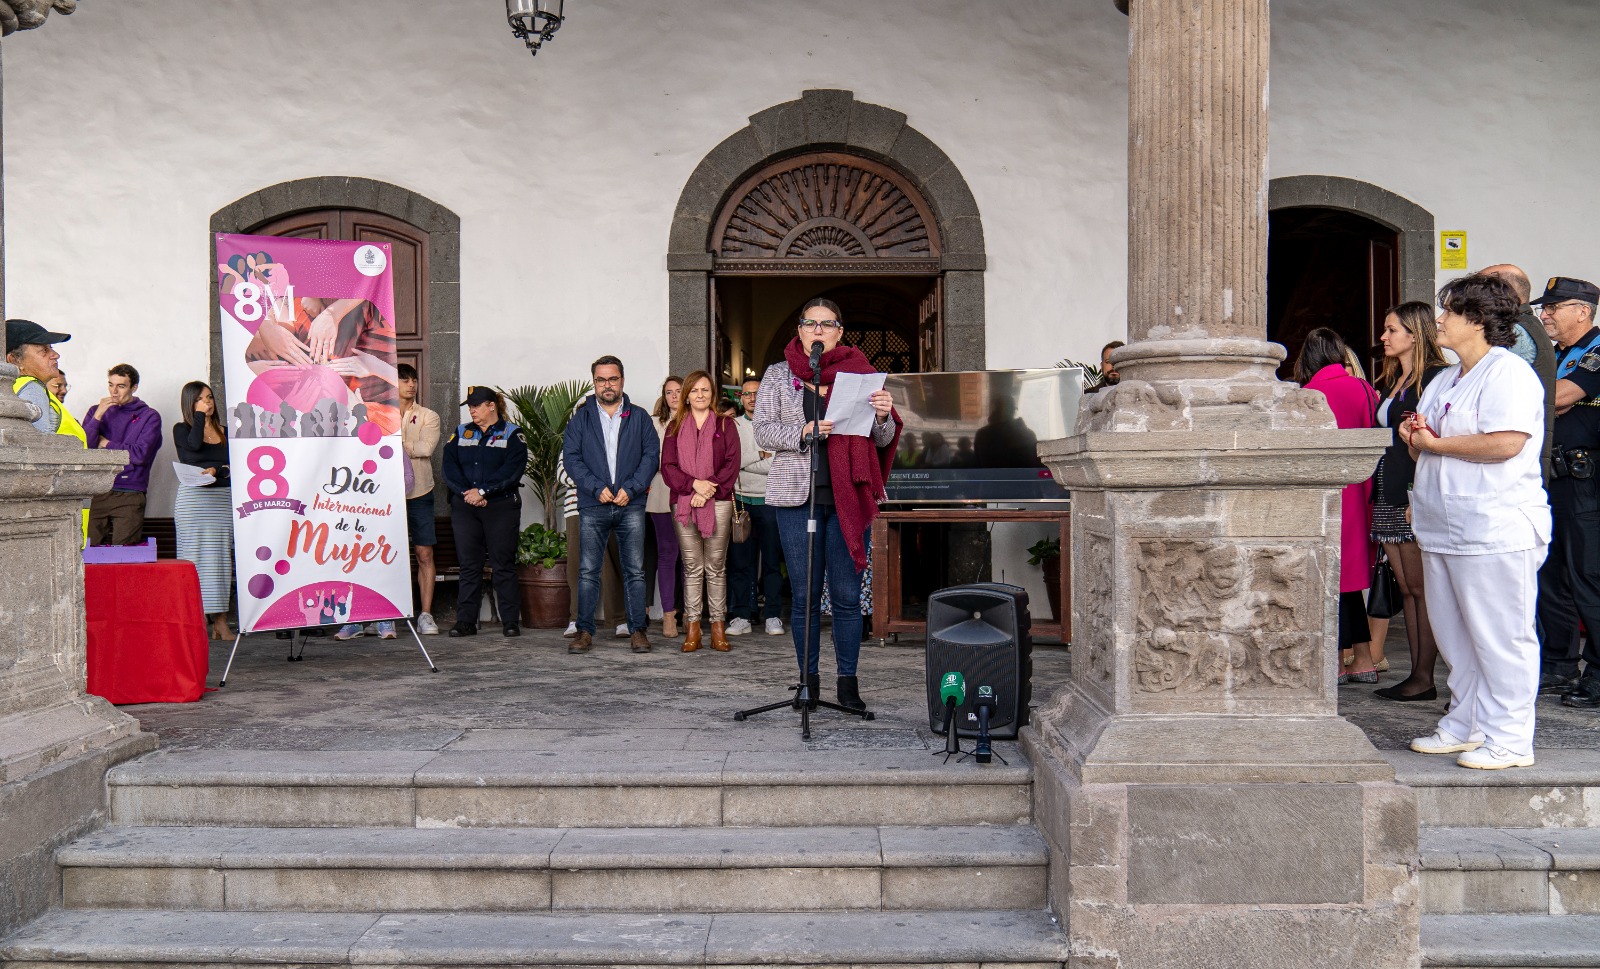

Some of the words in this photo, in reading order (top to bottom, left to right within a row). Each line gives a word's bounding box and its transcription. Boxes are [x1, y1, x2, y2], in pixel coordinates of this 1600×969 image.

[233, 282, 296, 322] 8M
[246, 445, 290, 501] 8
[322, 466, 381, 495] Día
[252, 502, 264, 510] DE
[264, 500, 292, 508] MARZO
[312, 493, 392, 516] Internacional
[335, 519, 351, 532] de
[354, 518, 368, 533] la
[286, 519, 398, 575] Mujer
